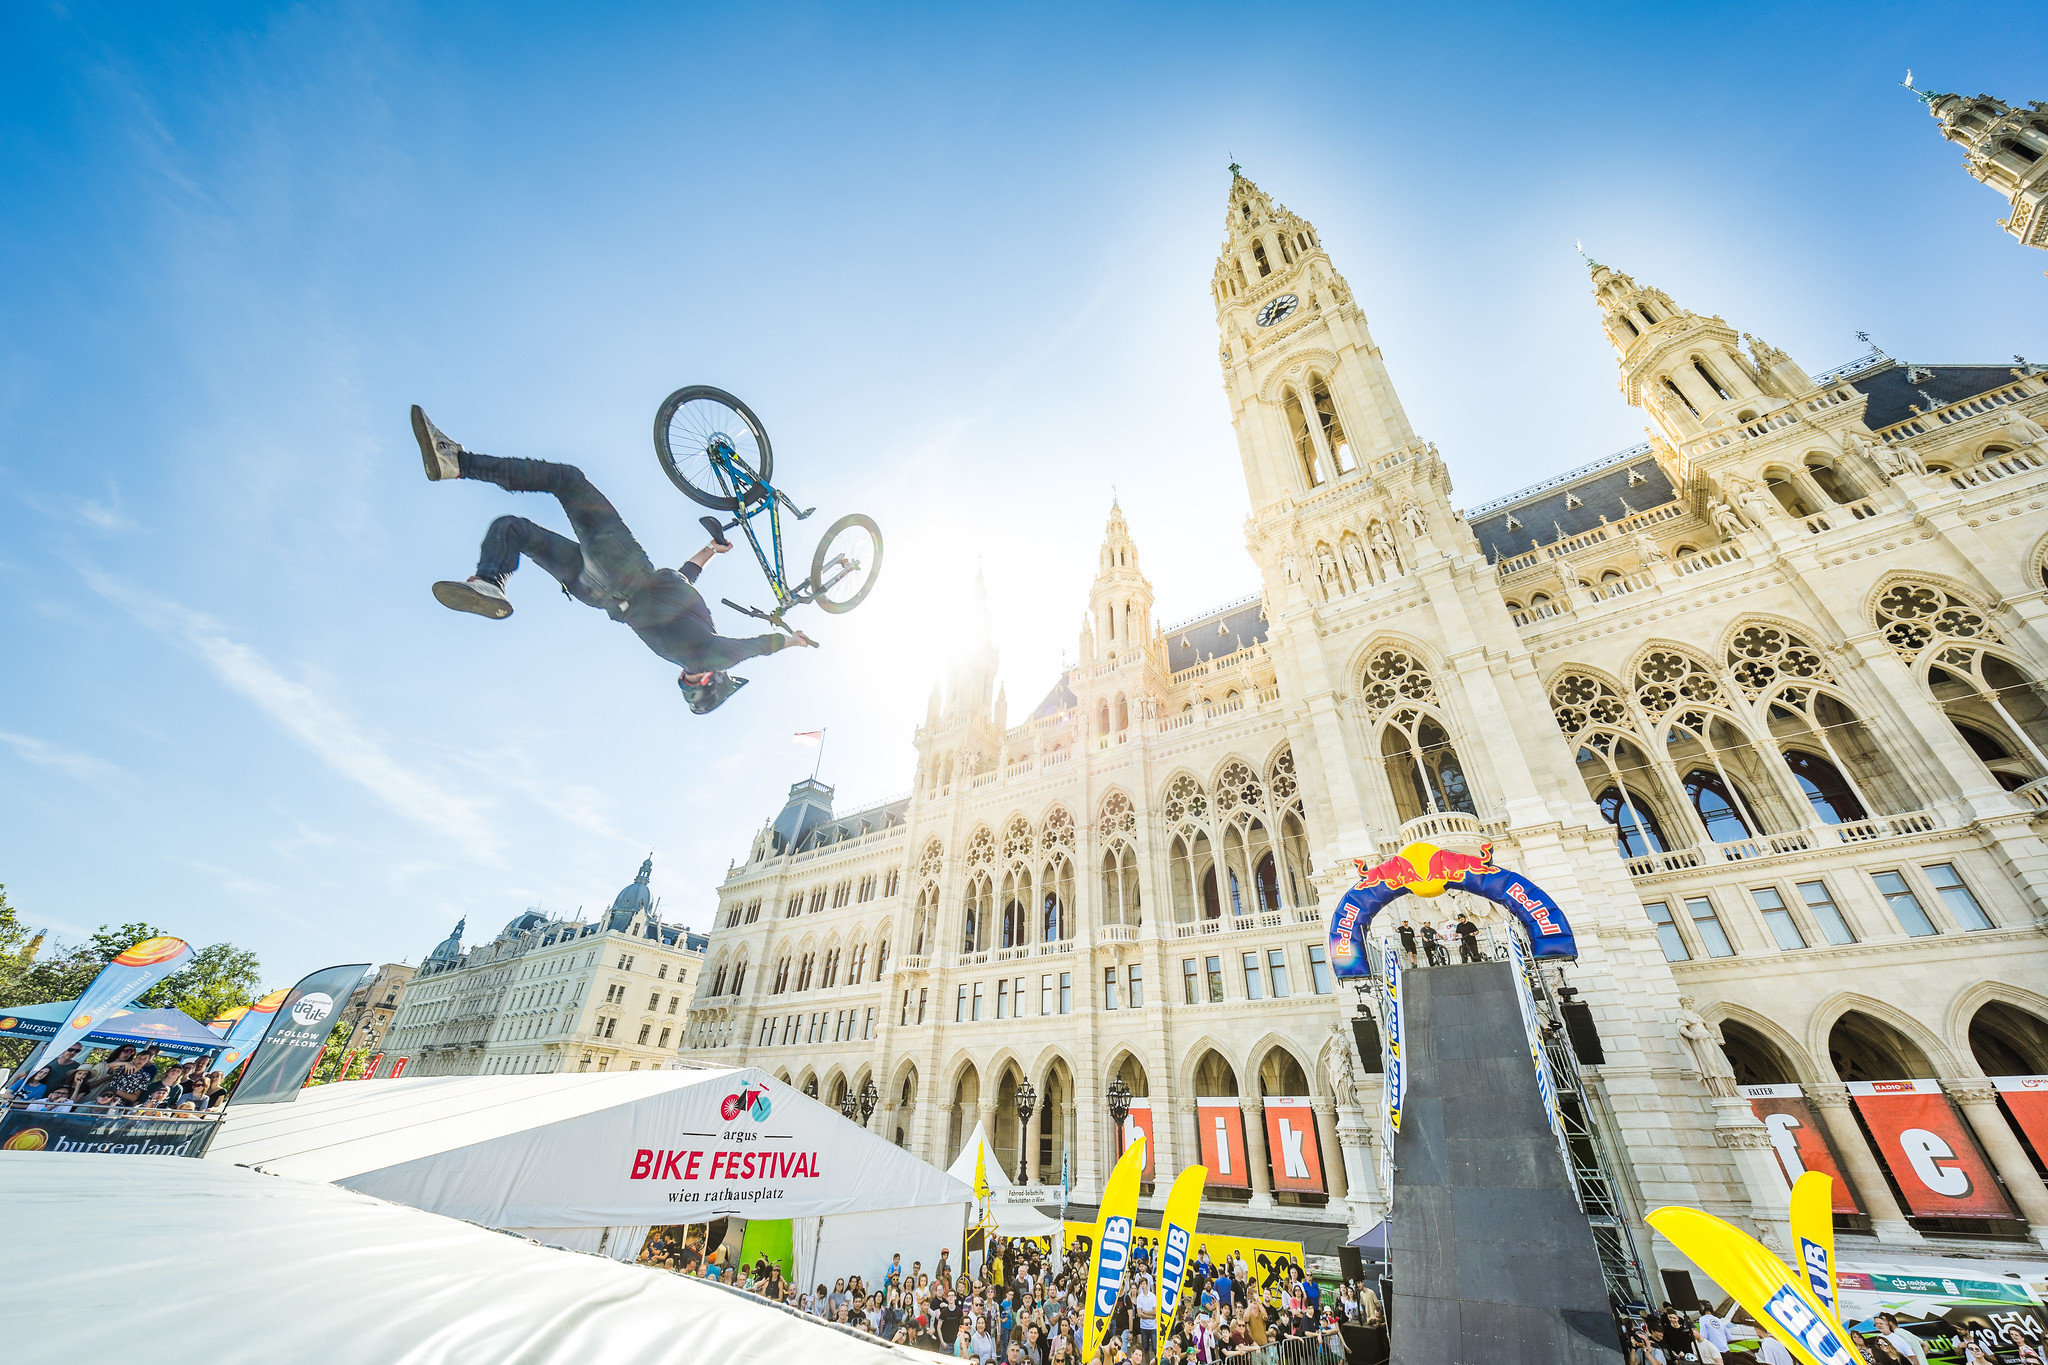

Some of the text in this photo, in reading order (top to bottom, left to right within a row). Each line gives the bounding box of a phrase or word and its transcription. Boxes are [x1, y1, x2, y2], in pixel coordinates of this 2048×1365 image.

[1337, 902, 1360, 956] Red Bull
[1506, 882, 1543, 912] Red
[1530, 907, 1562, 935] Bull
[19, 1021, 57, 1033] burgen
[294, 1002, 327, 1021] trails
[267, 1037, 320, 1048] THE FLOW.
[277, 1029, 320, 1040] FOLLOW
[1748, 1087, 1774, 1096] FALTER
[723, 1130, 758, 1143] argus
[1215, 1117, 1231, 1175] i
[1278, 1118, 1311, 1178] k
[1765, 1113, 1805, 1191] f
[630, 1148, 821, 1180] BIKE FESTIVAL
[1900, 1128, 1969, 1196] e
[668, 1186, 784, 1203] wien rathausplatz
[1097, 1217, 1131, 1315] CLUB
[1161, 1227, 1188, 1314] CLUB
[1907, 1280, 1938, 1288] cashback
[1771, 1294, 1856, 1365] UB
